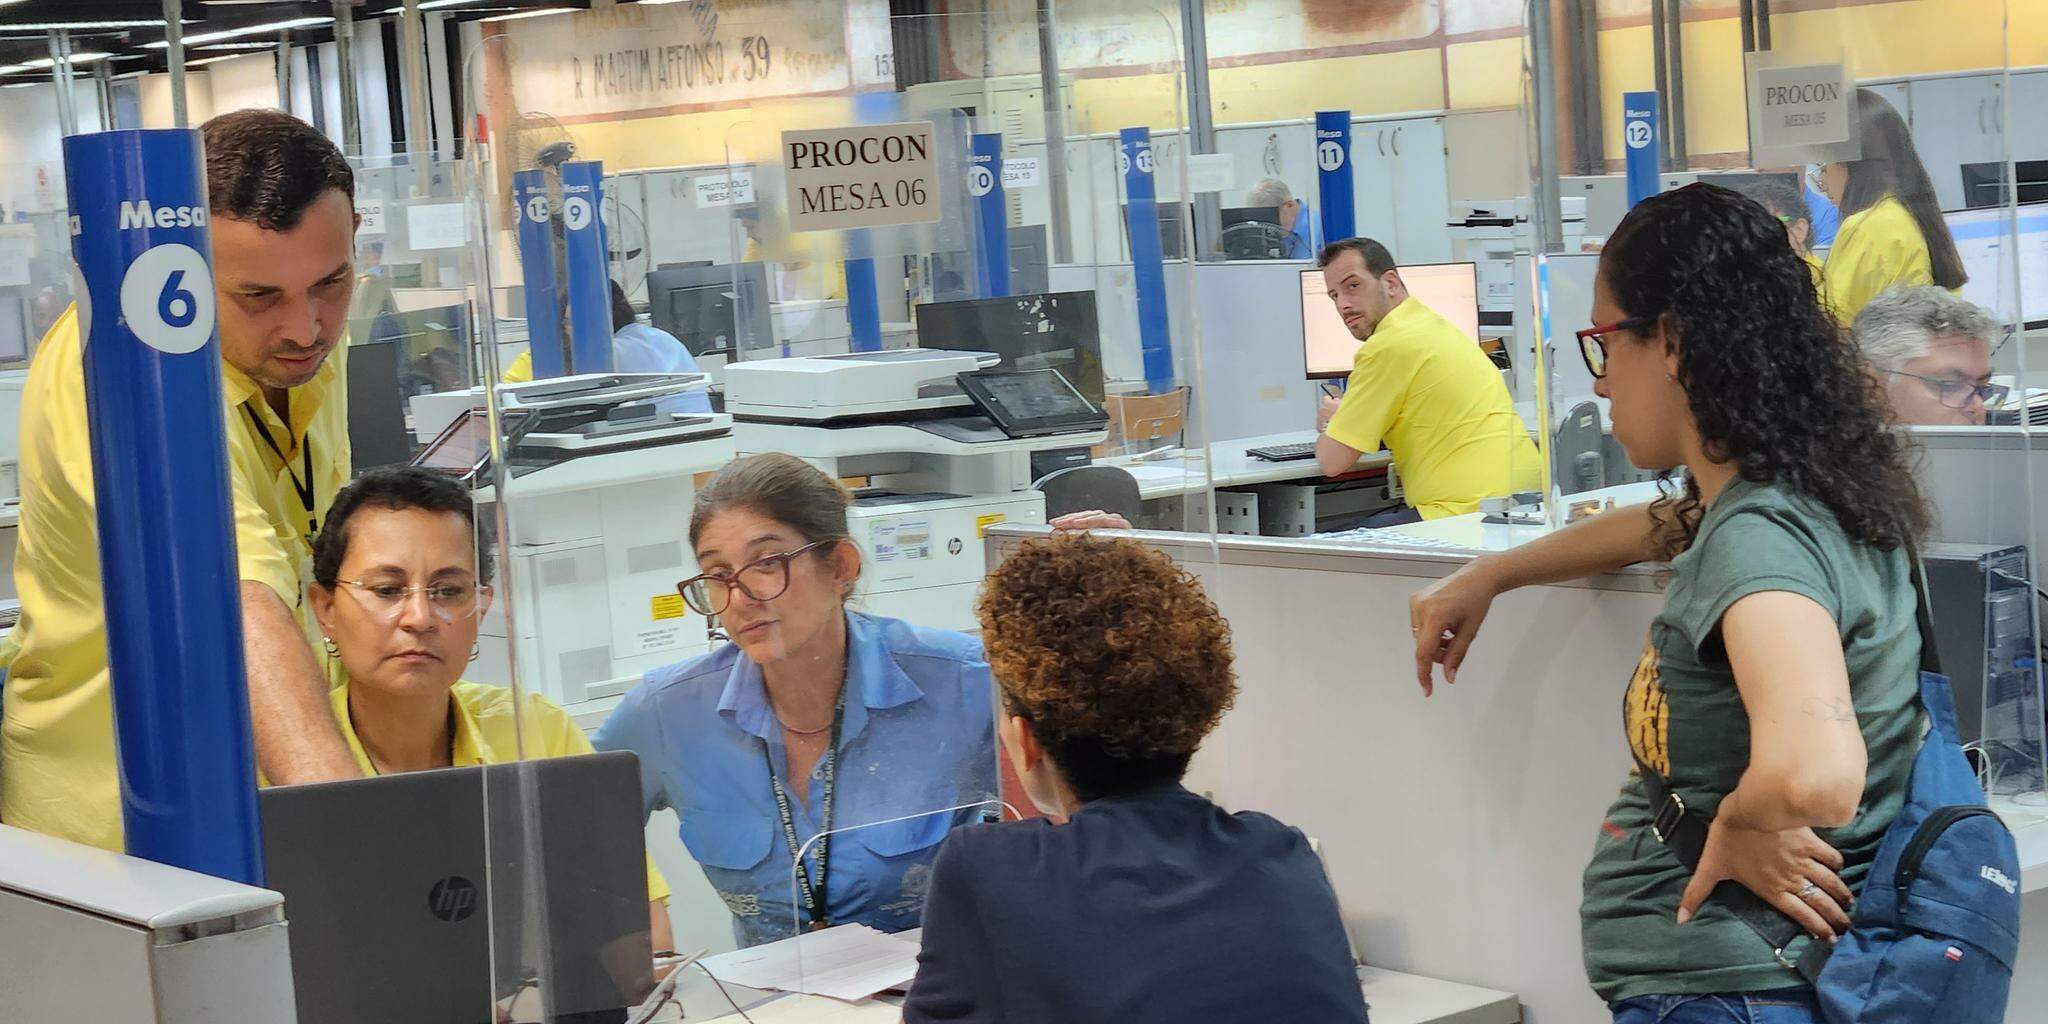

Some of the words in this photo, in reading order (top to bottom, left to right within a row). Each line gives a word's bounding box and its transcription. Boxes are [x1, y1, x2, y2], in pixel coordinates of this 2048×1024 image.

[658, 40, 724, 90] AFFONSO
[742, 35, 771, 81] 39
[1765, 82, 1840, 106] PROCON
[1629, 127, 1648, 142] 12
[788, 134, 927, 169] PROCON
[1321, 149, 1338, 163] 11
[799, 182, 889, 214] MESA
[895, 178, 927, 207] 06
[119, 199, 207, 231] Mesa
[569, 204, 581, 222] 9
[158, 270, 197, 328] 6
[435, 877, 475, 923] hp
